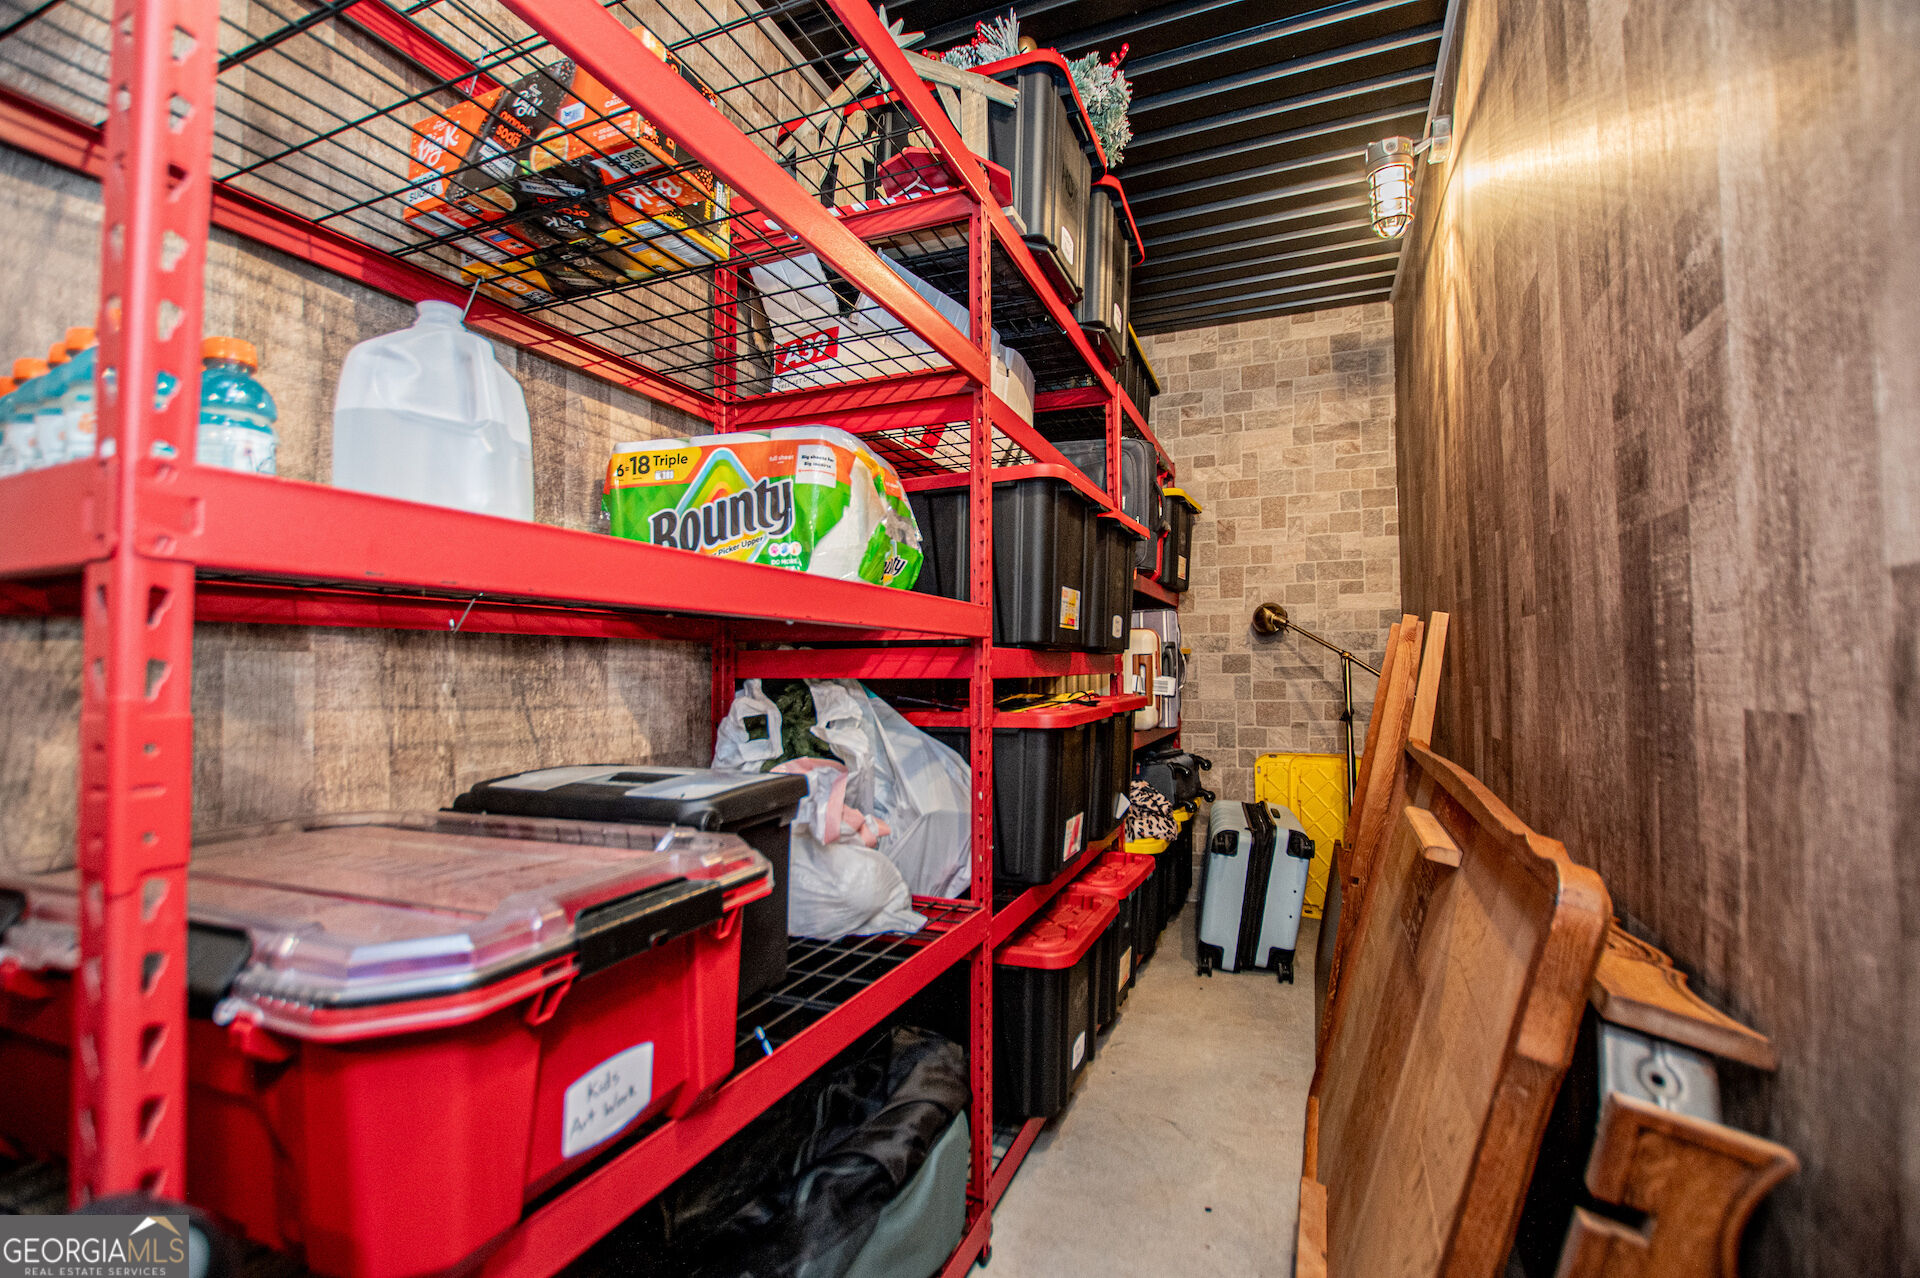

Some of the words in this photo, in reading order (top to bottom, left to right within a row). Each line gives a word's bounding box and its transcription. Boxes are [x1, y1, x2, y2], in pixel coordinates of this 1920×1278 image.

[496, 123, 522, 148] soda
[783, 334, 829, 368] A39
[653, 454, 688, 468] Triple
[650, 478, 794, 552] Bounty
[718, 544, 739, 556] Picker
[741, 536, 763, 548] Upper
[587, 1071, 620, 1102] Kids
[570, 1110, 595, 1141] Art
[604, 1085, 637, 1117] Work
